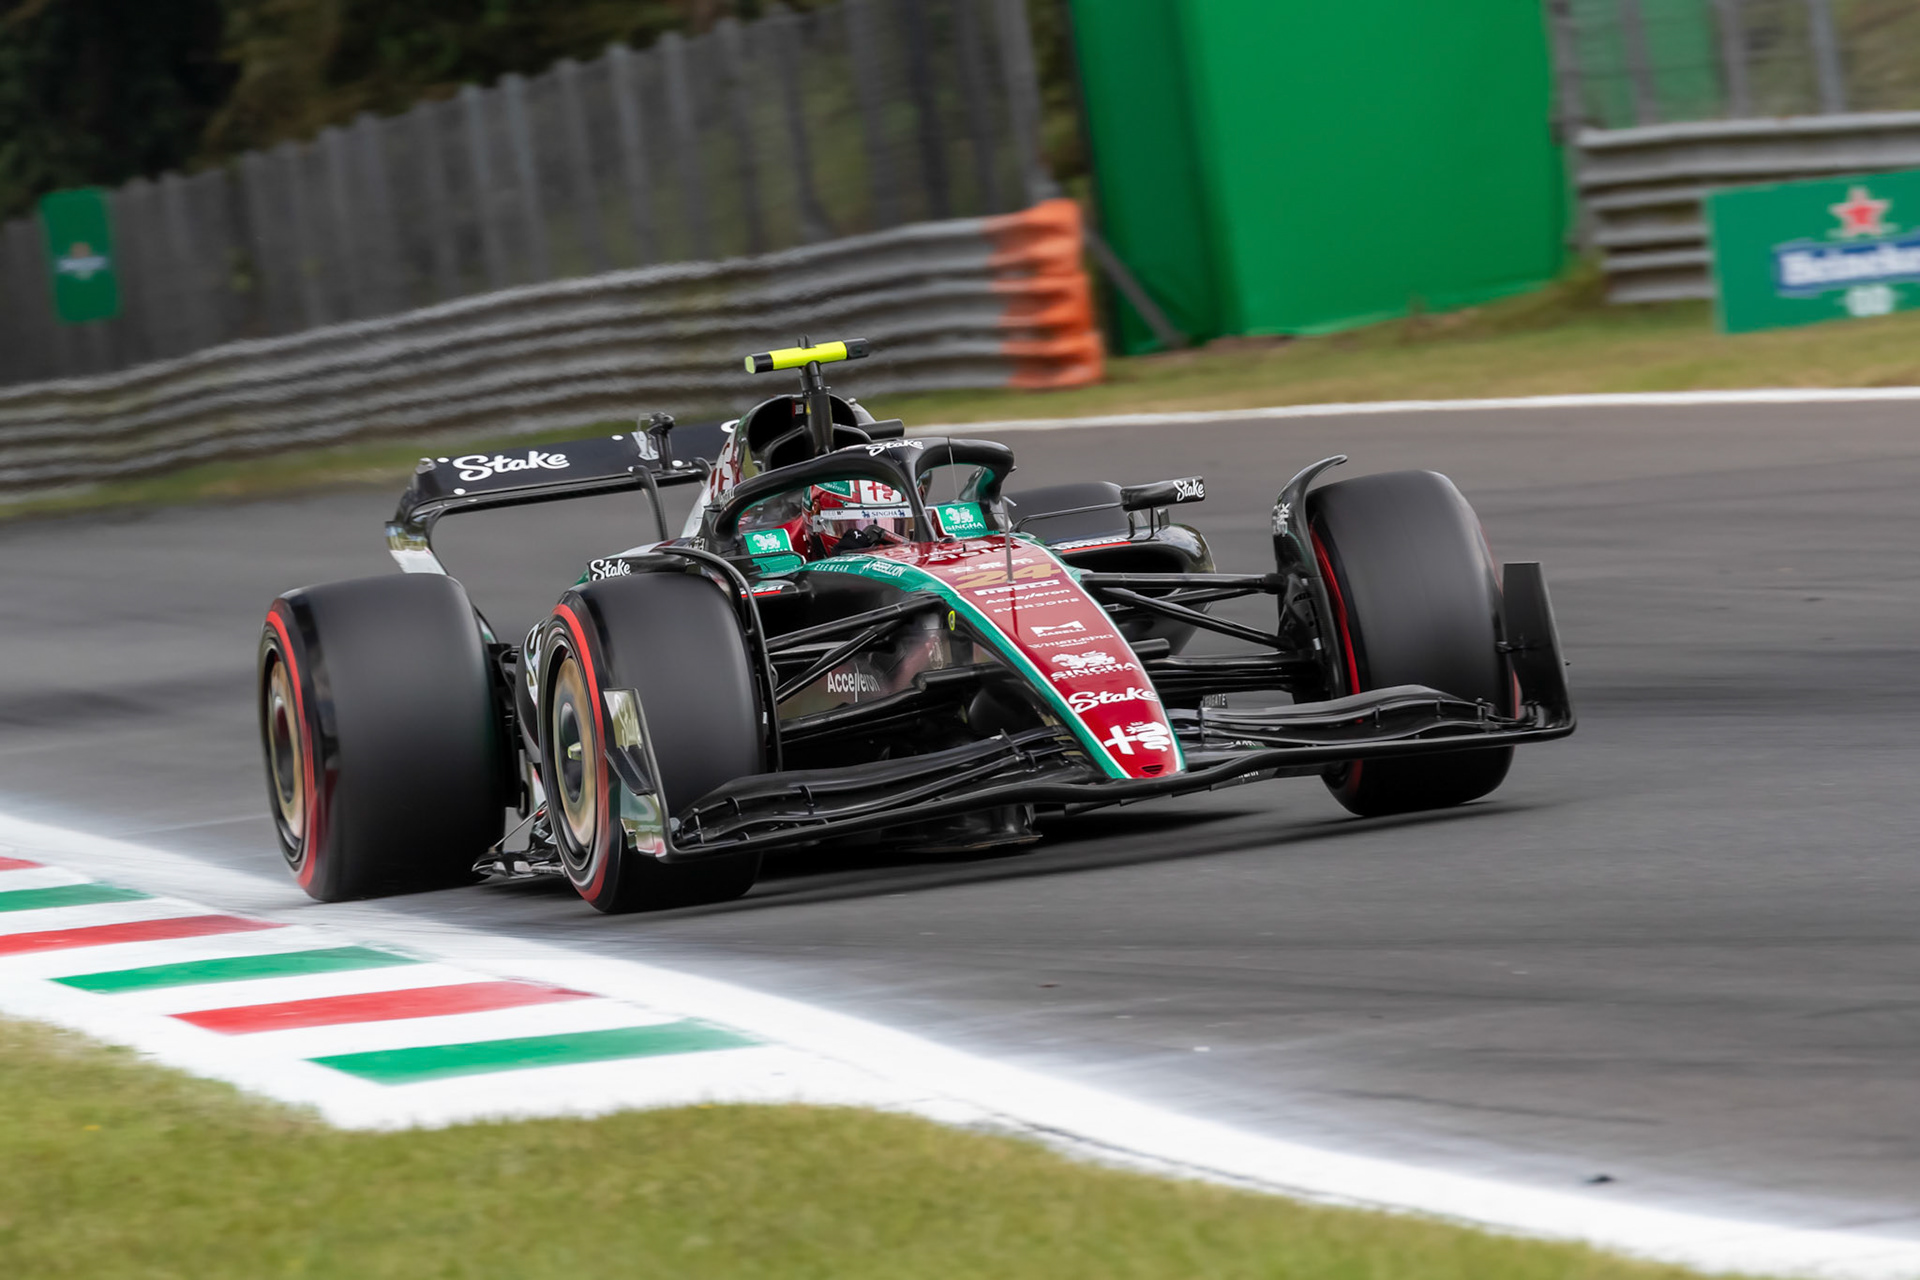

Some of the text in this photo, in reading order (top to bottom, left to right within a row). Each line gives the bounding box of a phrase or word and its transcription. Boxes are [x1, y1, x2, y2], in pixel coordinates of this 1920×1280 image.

[865, 440, 924, 457] Stake
[453, 451, 570, 481] Stake
[1173, 479, 1205, 502] Stake
[945, 522, 984, 531] SINGHA
[590, 559, 631, 581] Stake
[955, 563, 1061, 589] 24
[1050, 662, 1139, 679] SINGHA
[1068, 687, 1159, 713] Stake
